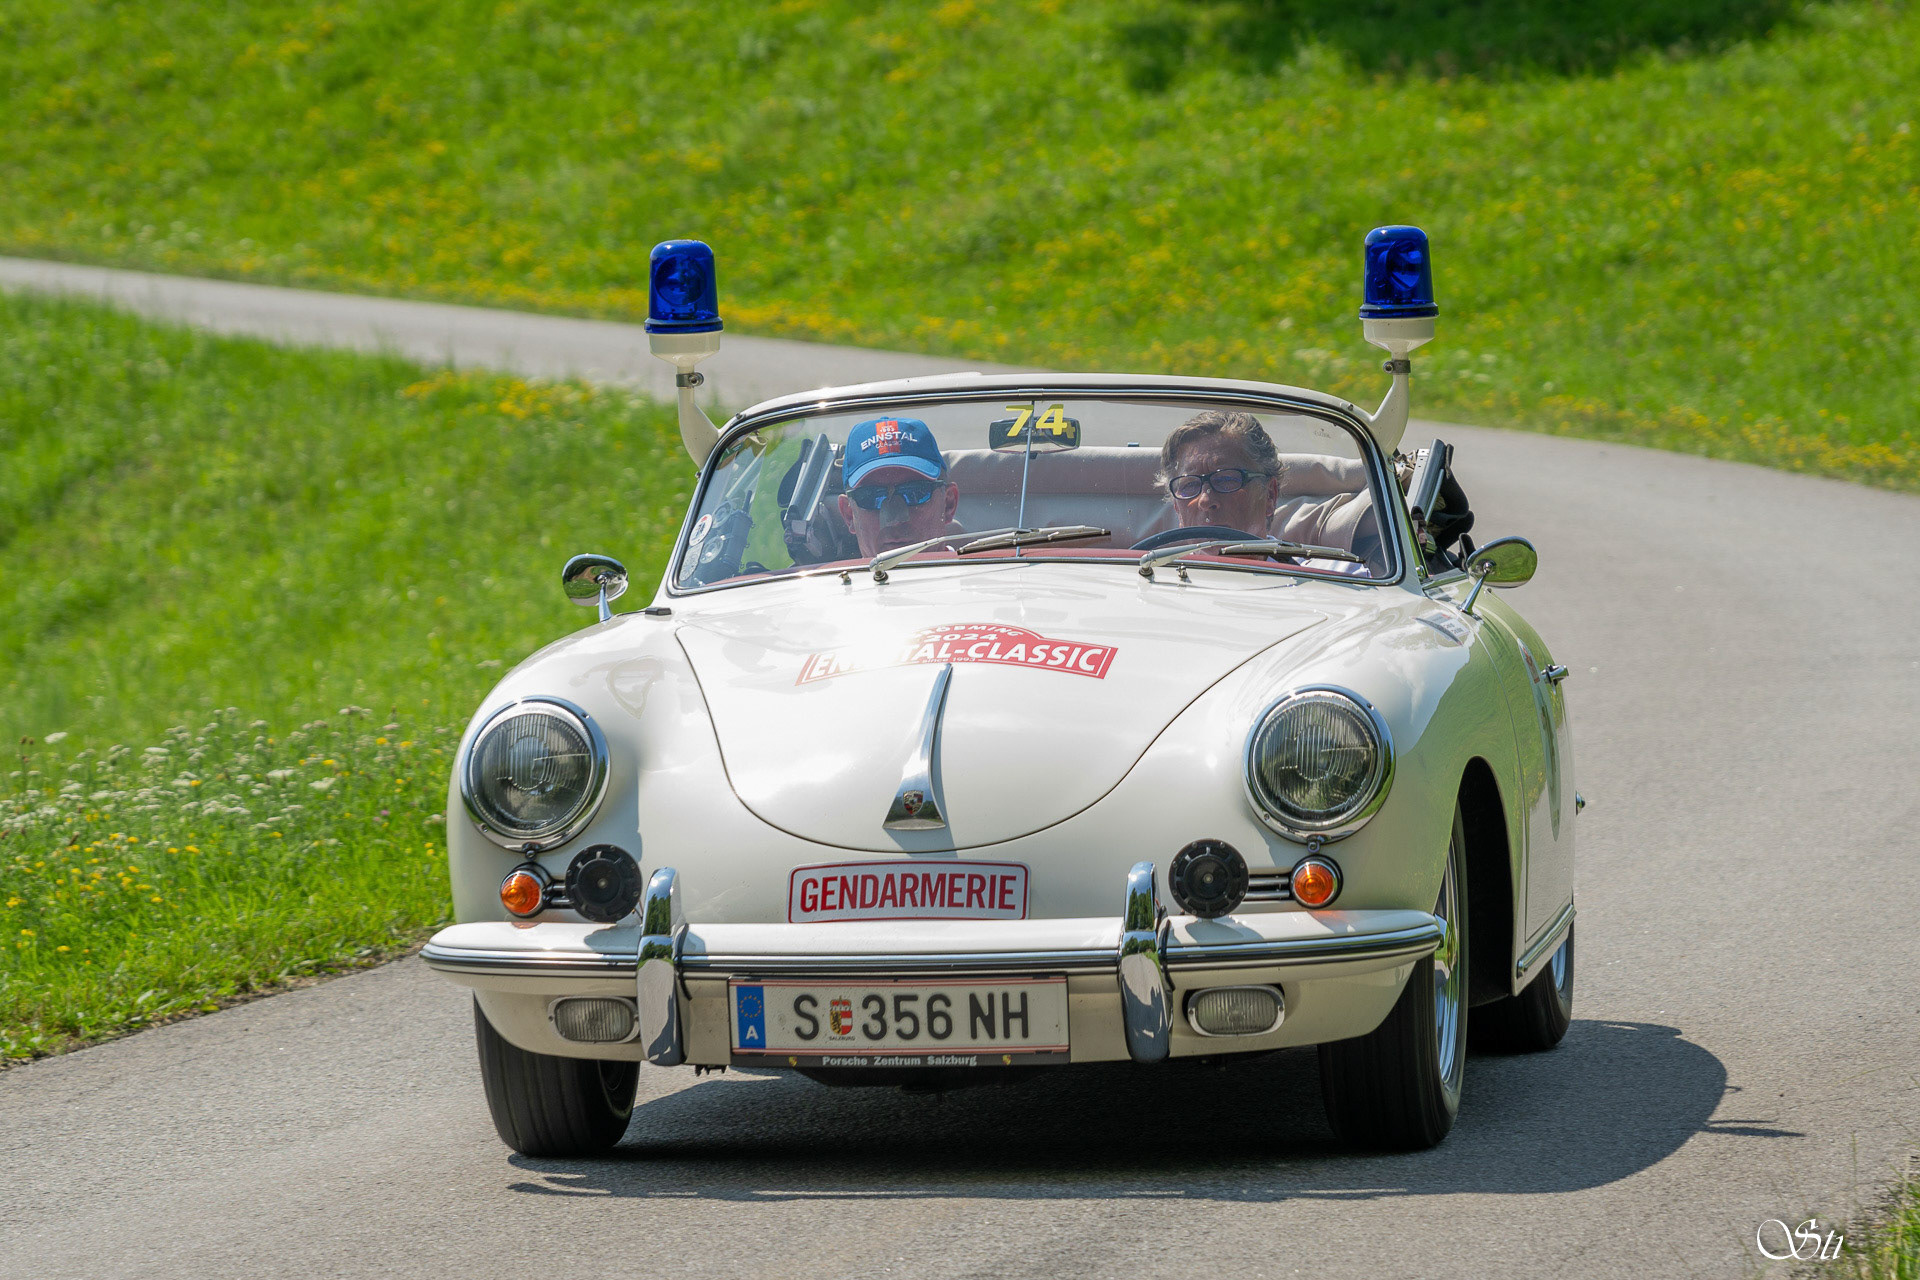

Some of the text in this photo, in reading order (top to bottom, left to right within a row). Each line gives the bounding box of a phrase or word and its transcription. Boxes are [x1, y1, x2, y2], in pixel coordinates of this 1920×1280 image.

[1006, 404, 1068, 437] 74
[861, 431, 918, 451] ENNSTAL
[923, 633, 998, 642] 2024
[800, 873, 1017, 913] GENDARMERIE
[793, 991, 1029, 1040] S 356 NH
[745, 1025, 759, 1040] A
[822, 1055, 978, 1067] Porsche Zentrum Salzburg
